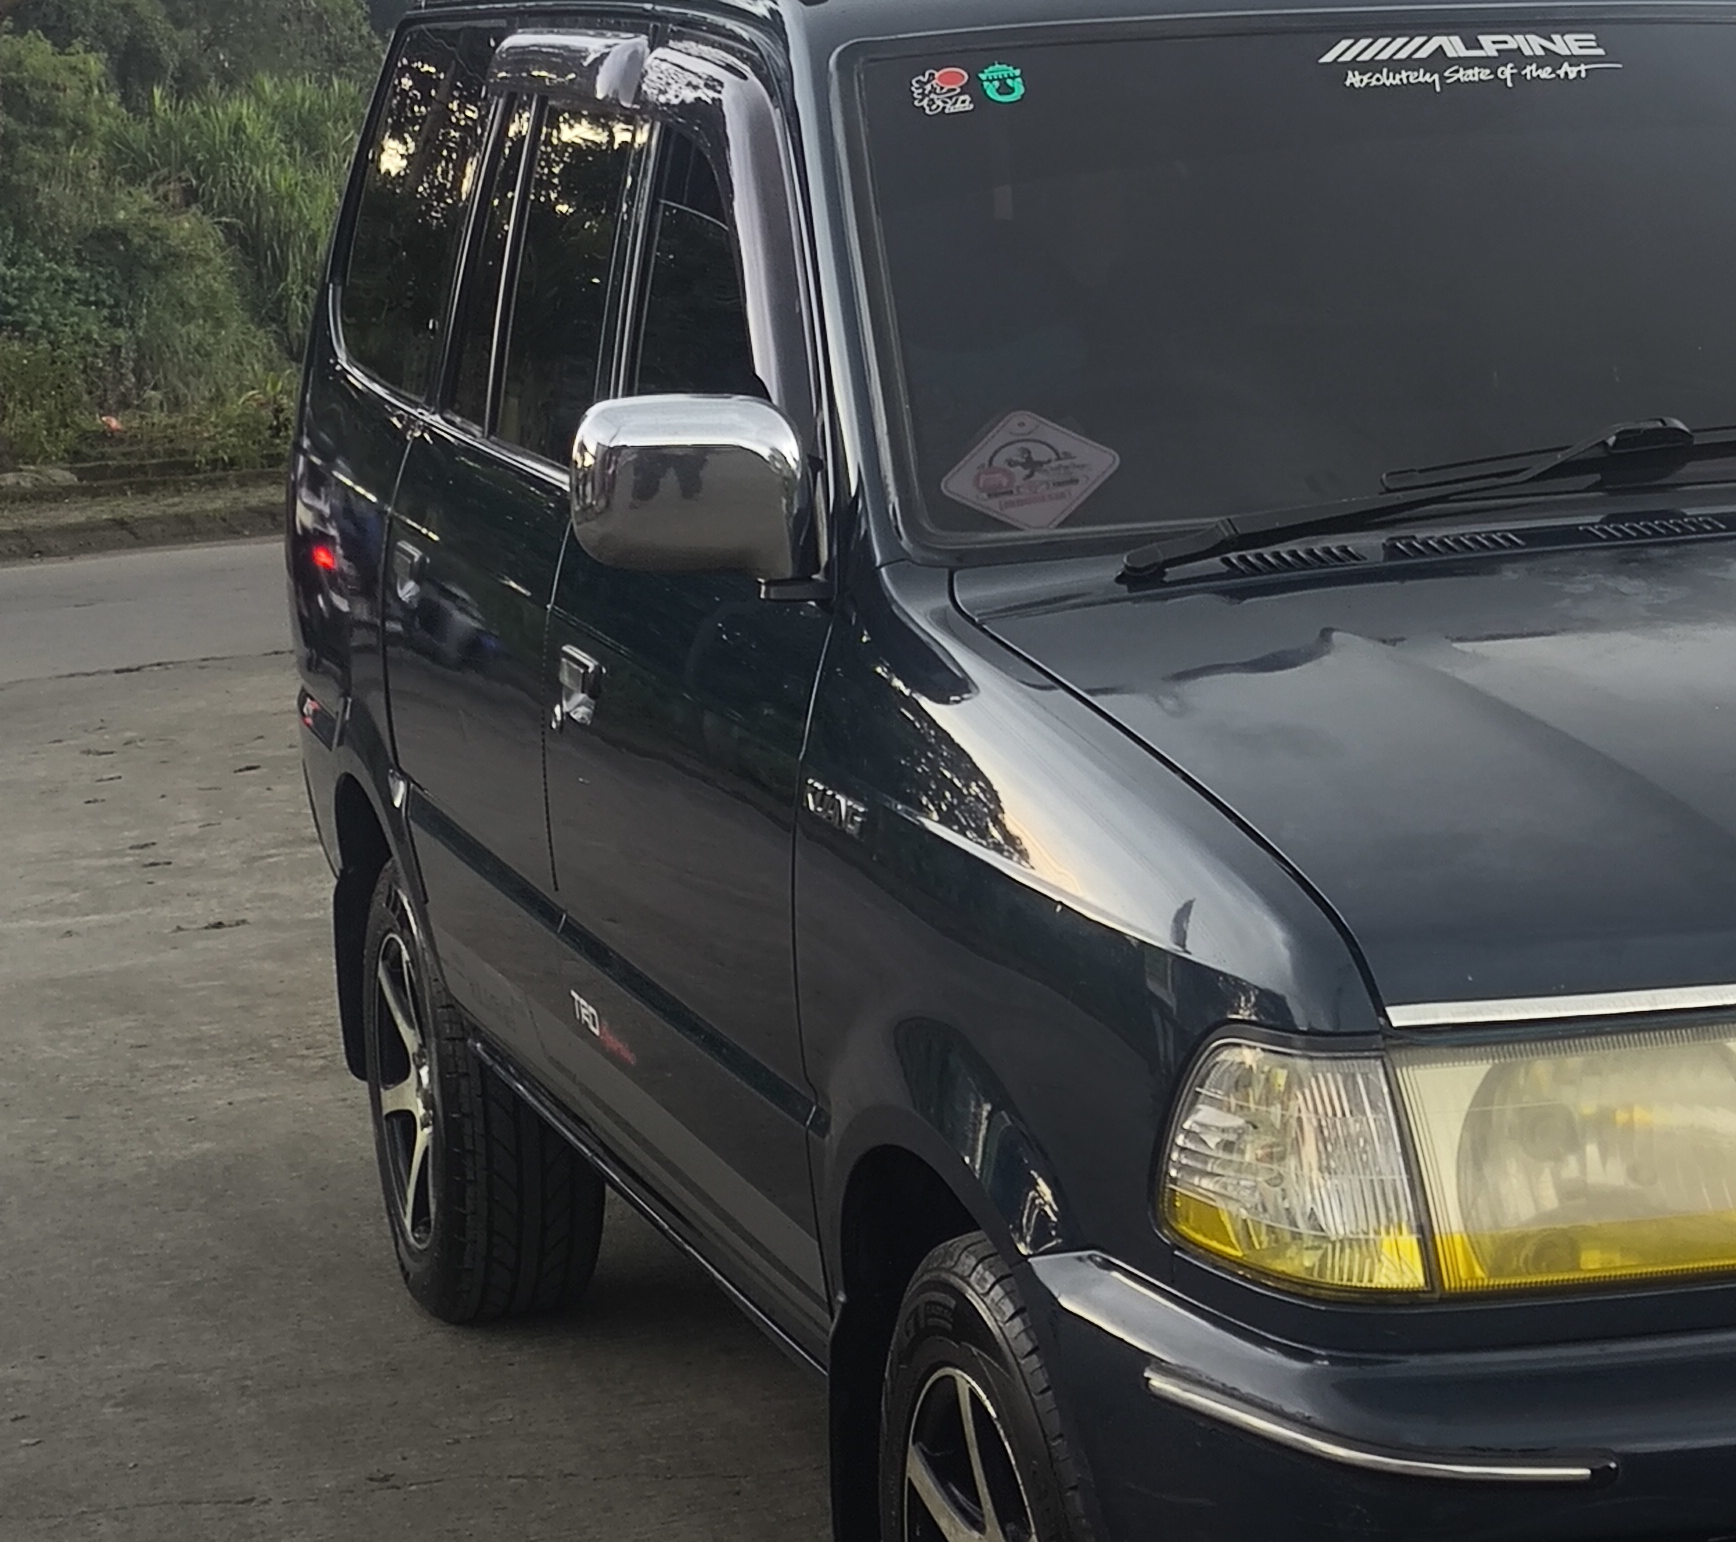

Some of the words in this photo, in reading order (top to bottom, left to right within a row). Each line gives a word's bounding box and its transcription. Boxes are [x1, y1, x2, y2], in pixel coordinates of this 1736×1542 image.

[1411, 33, 1606, 59] ALPINE
[1345, 69, 1441, 92] Absolutely
[1445, 65, 1494, 85] State
[1556, 63, 1623, 79] Art
